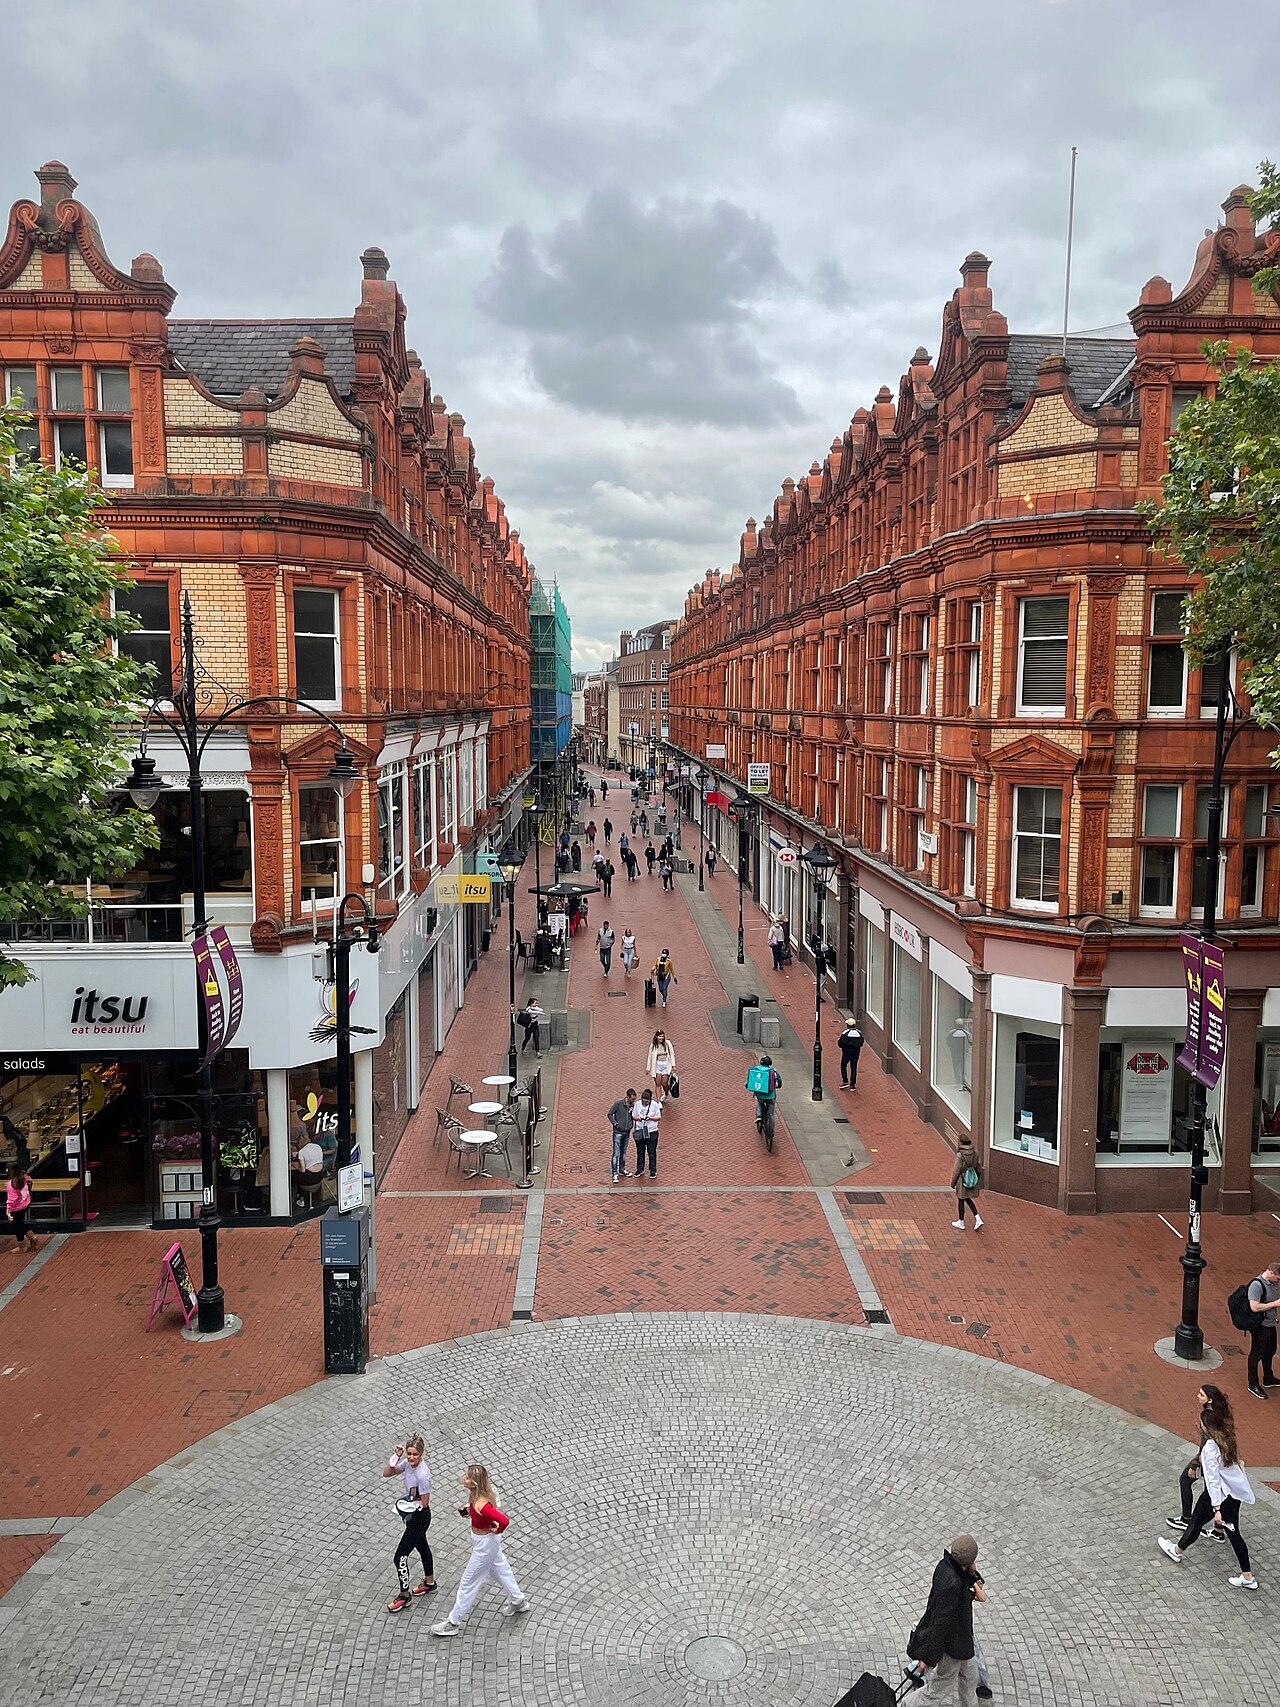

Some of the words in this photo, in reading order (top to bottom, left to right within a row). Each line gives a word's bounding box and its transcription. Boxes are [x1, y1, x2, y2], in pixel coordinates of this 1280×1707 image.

[464, 884, 487, 895] itsu
[70, 986, 149, 1024] itsu
[71, 1026, 90, 1034] eat
[93, 1025, 146, 1034] beautiful
[3, 1057, 45, 1070] salads
[398, 1556, 408, 1589] adidas
